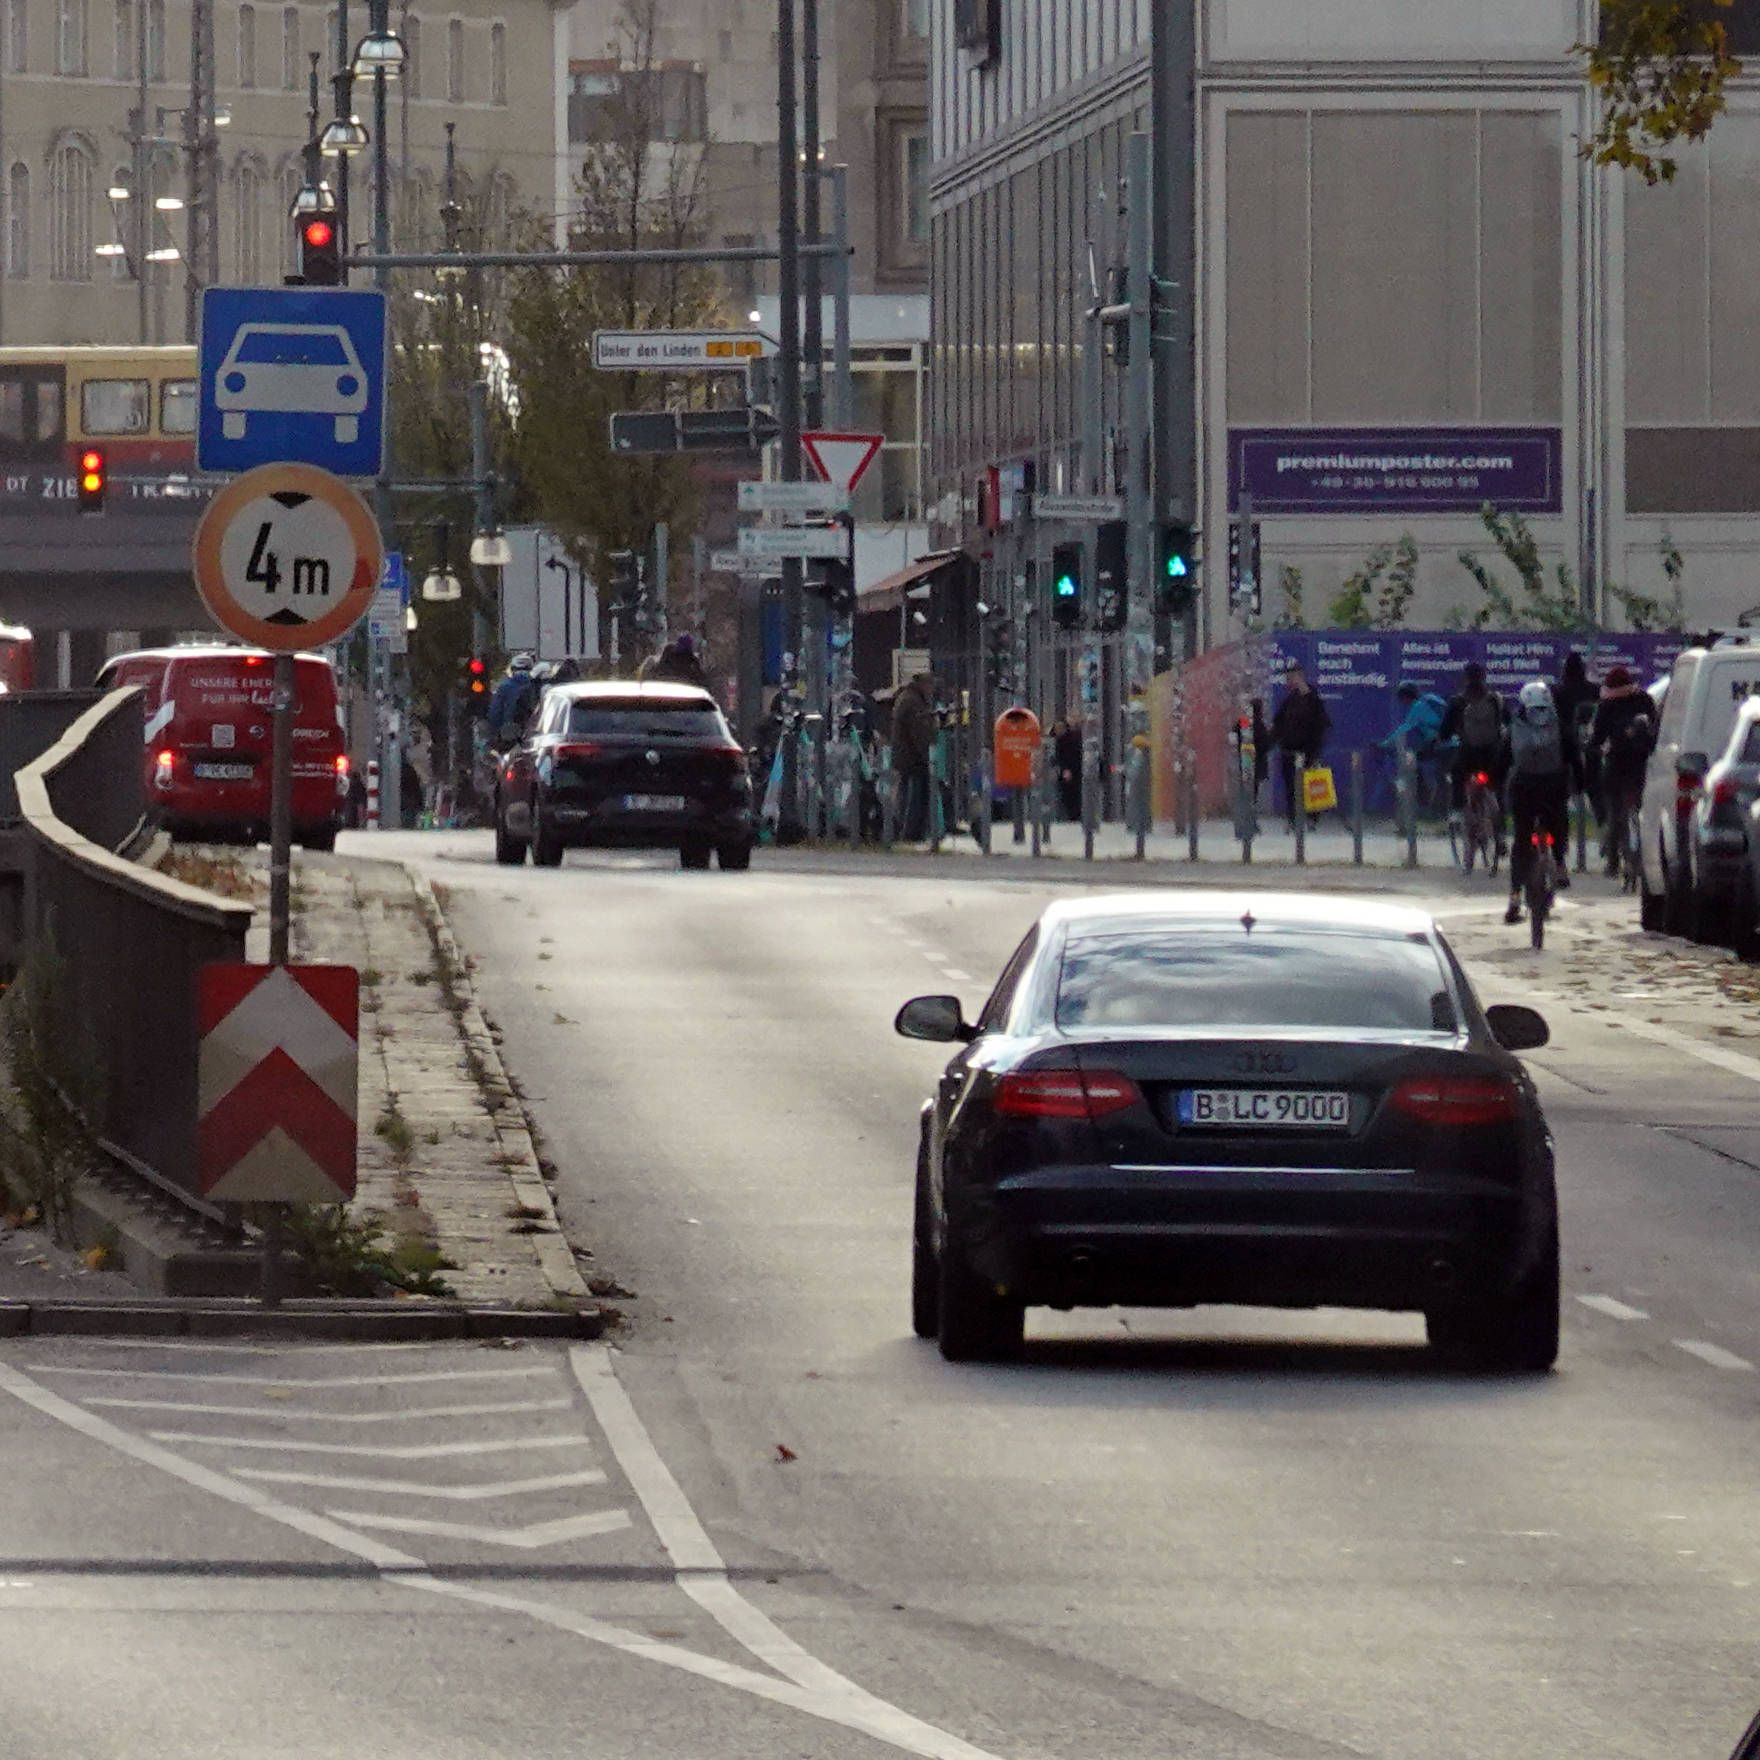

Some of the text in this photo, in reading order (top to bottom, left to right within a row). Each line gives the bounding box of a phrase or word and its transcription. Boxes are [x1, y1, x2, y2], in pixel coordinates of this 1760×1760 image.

[600, 343, 631, 358] Unter
[637, 344, 659, 358] den
[663, 343, 702, 358] Linden
[1276, 454, 1513, 472] premiumposter.com
[246, 521, 329, 595] 4 m
[1197, 1094, 1345, 1121] B LC 9000
